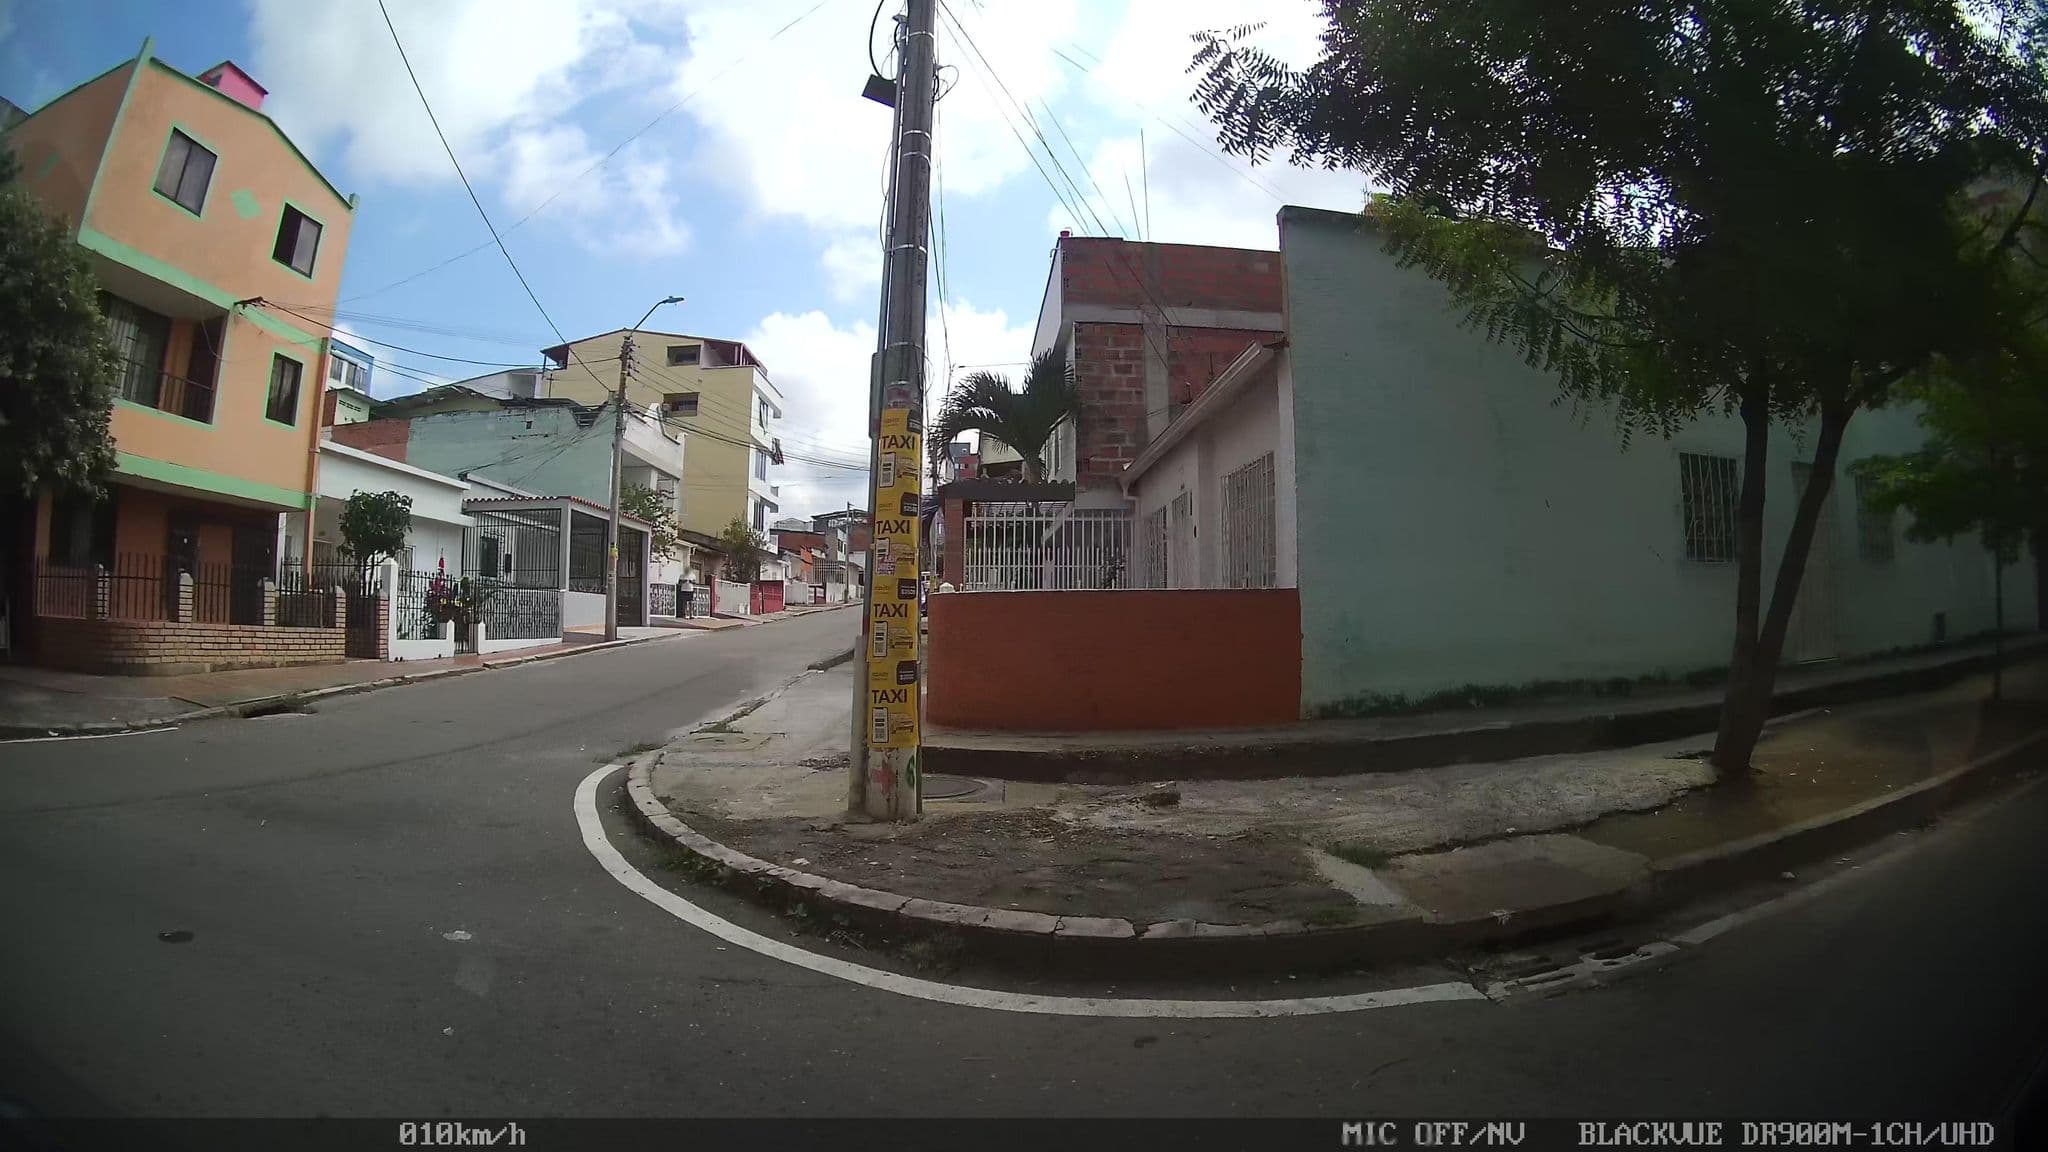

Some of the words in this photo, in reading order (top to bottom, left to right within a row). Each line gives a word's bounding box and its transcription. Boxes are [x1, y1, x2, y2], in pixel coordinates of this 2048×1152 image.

[882, 435, 915, 450] TAXI
[876, 520, 910, 535] TAXI
[874, 604, 908, 618] TAXI
[872, 689, 907, 704] TAXI
